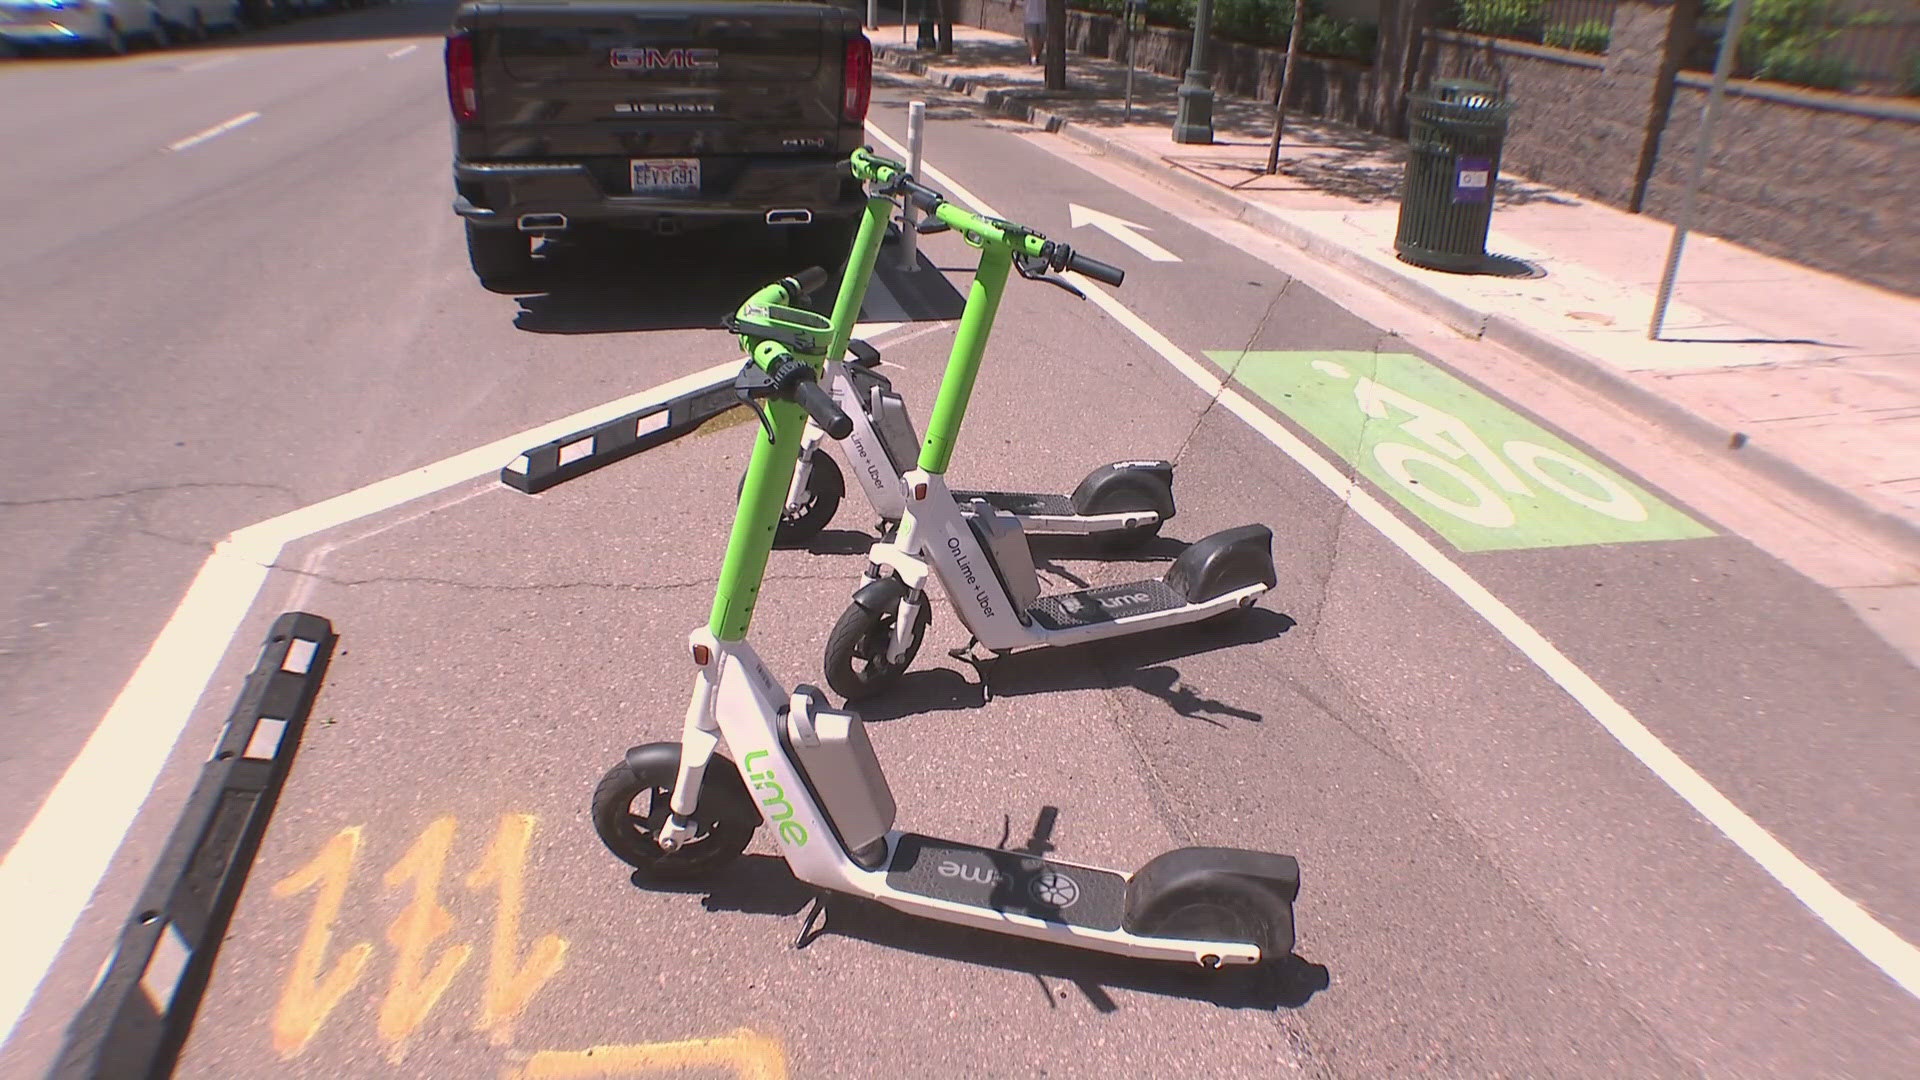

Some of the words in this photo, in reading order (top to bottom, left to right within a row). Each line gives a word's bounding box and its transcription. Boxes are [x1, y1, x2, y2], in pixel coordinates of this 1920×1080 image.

[610, 48, 719, 69] GMC
[867, 465, 884, 489] Uber
[947, 537, 962, 557] On
[956, 555, 976, 585] Lime
[976, 590, 995, 618] Uber
[744, 749, 808, 847] Lime
